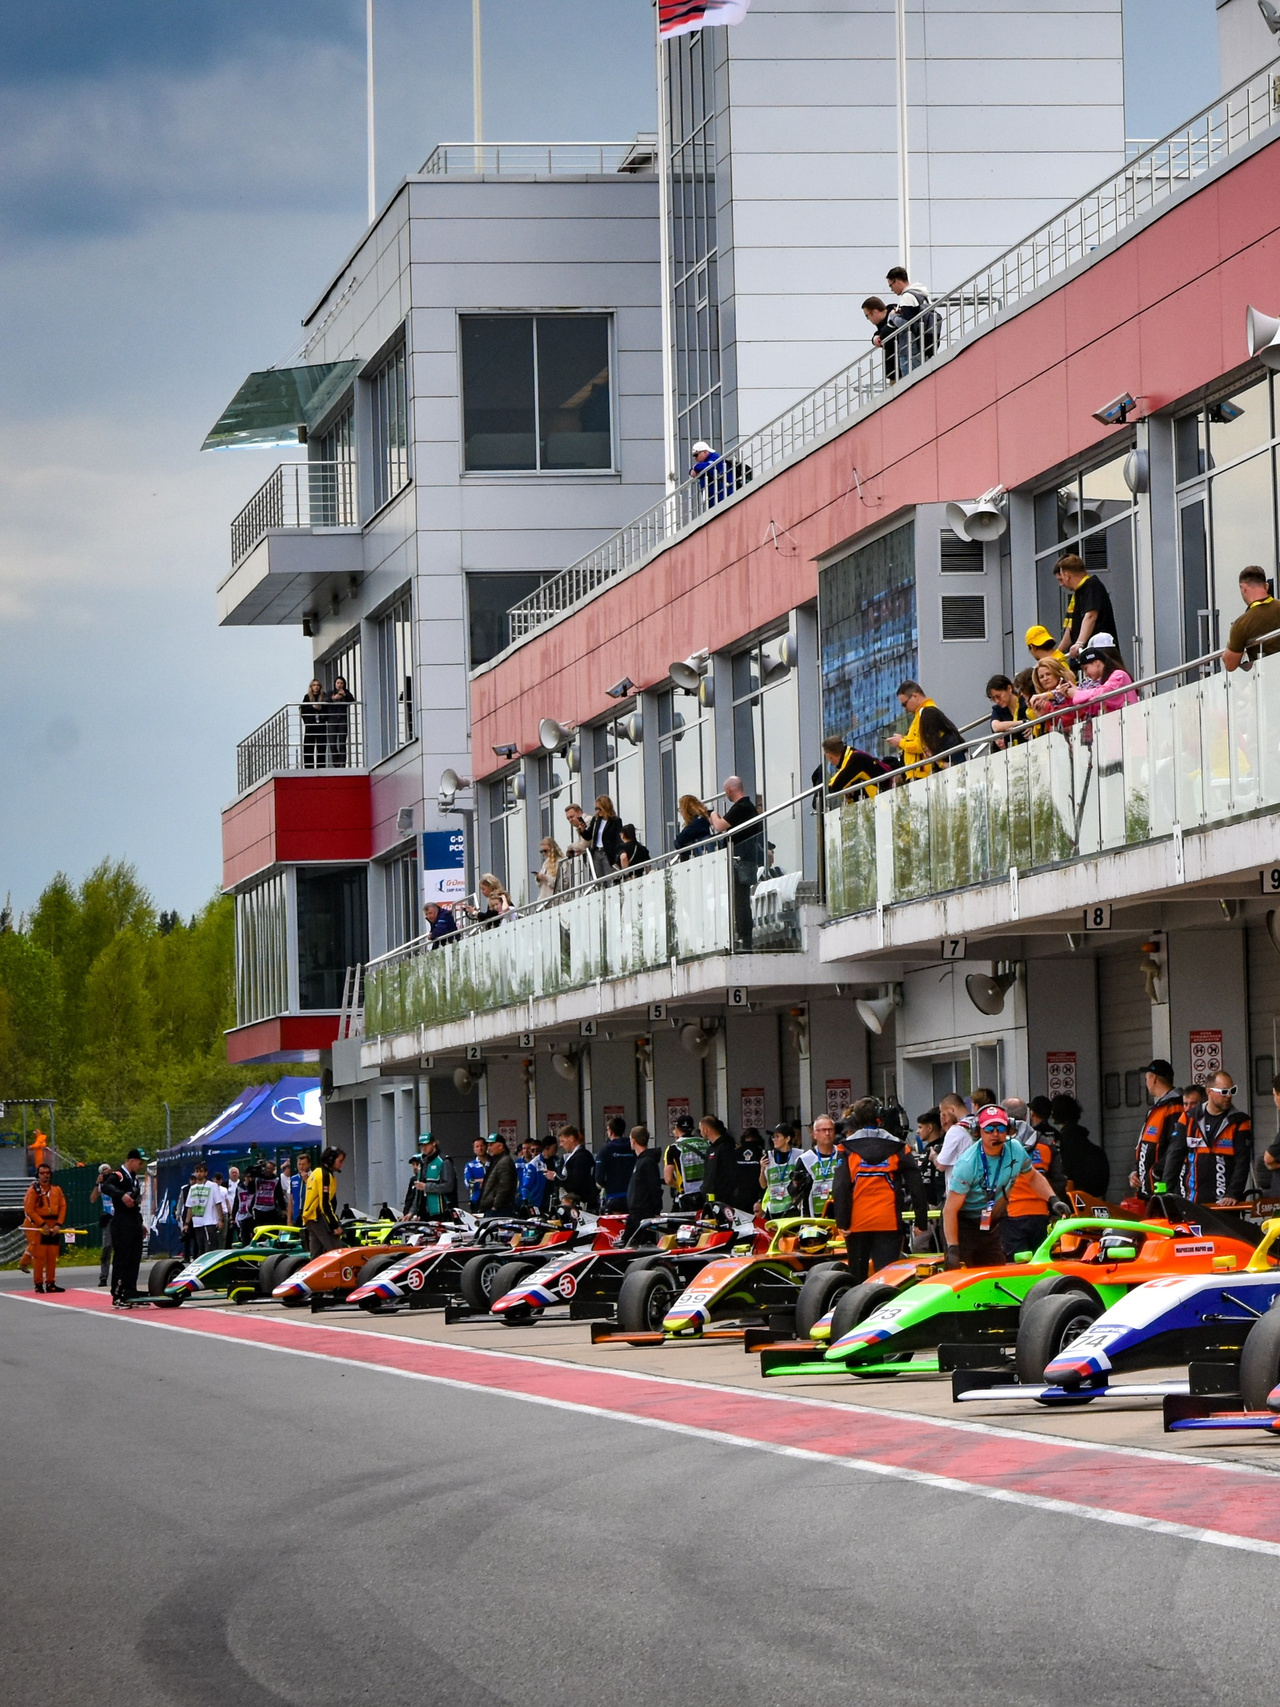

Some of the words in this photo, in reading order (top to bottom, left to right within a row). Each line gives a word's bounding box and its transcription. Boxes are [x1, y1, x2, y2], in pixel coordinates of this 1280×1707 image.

[1093, 907, 1104, 927] 8
[949, 940, 960, 956] 7
[734, 988, 742, 1004] 6
[654, 1005, 662, 1018] 5
[585, 1021, 593, 1035] 4
[524, 1034, 531, 1046] 3
[471, 1047, 478, 1059] 2
[425, 1056, 430, 1067] 1
[678, 1293, 707, 1304] 99
[870, 1308, 902, 1320] 73
[1072, 1334, 1109, 1349] 74
